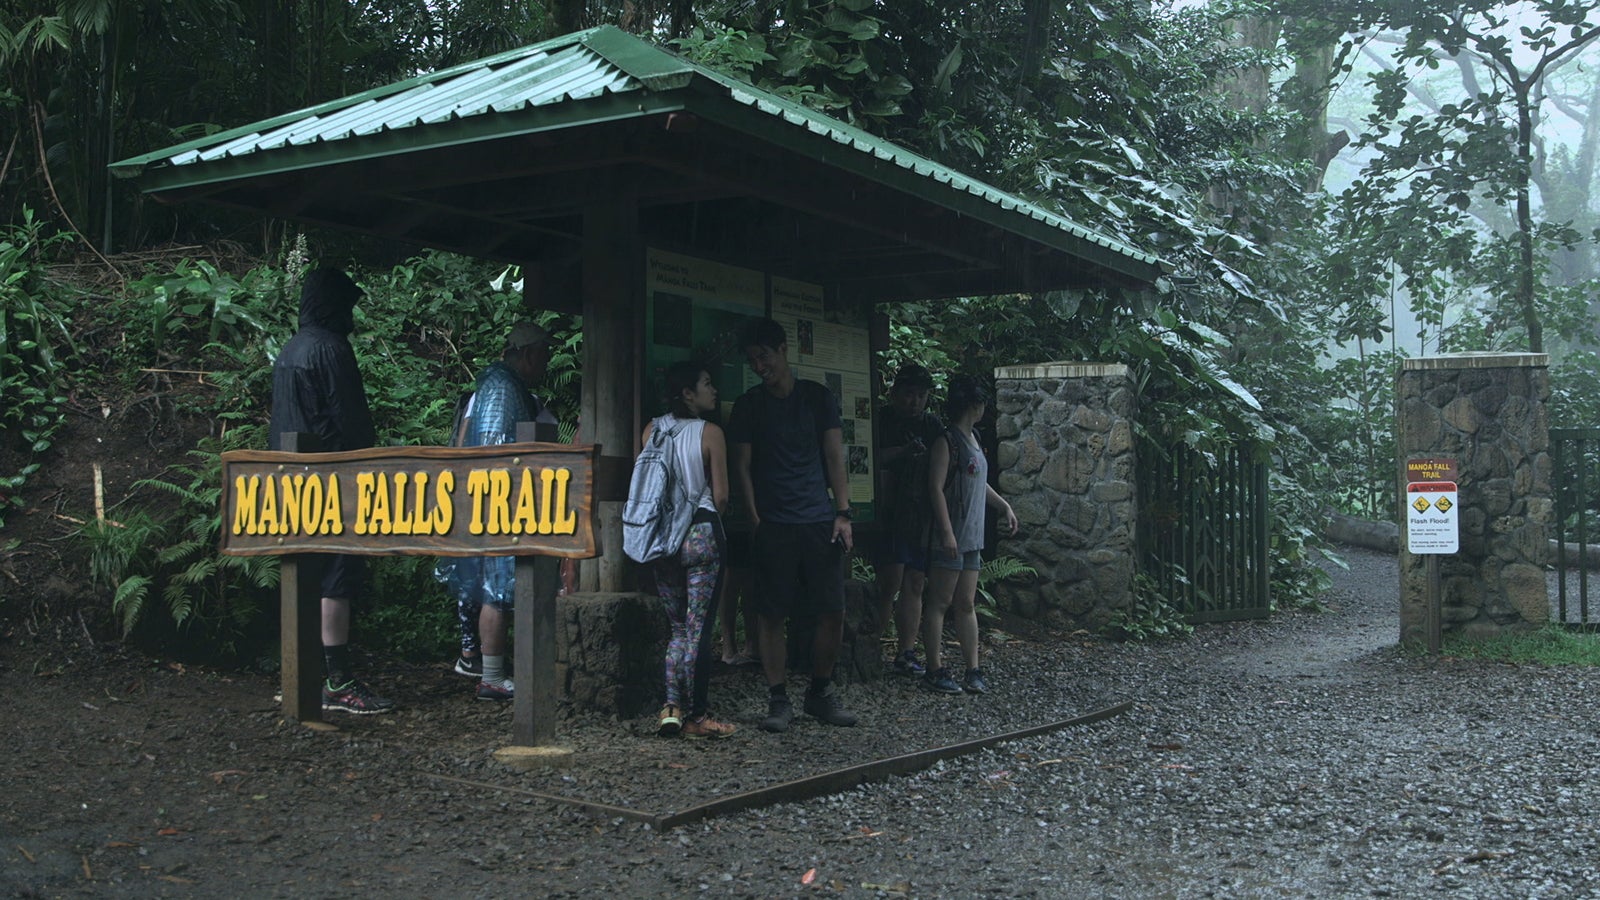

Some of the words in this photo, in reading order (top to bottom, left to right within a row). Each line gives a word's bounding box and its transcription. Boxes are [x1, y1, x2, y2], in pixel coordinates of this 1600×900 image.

[1422, 471, 1441, 479] TRAIL
[232, 471, 344, 536] MANOA
[353, 469, 456, 536] FALLS
[466, 466, 576, 536] TRAIL
